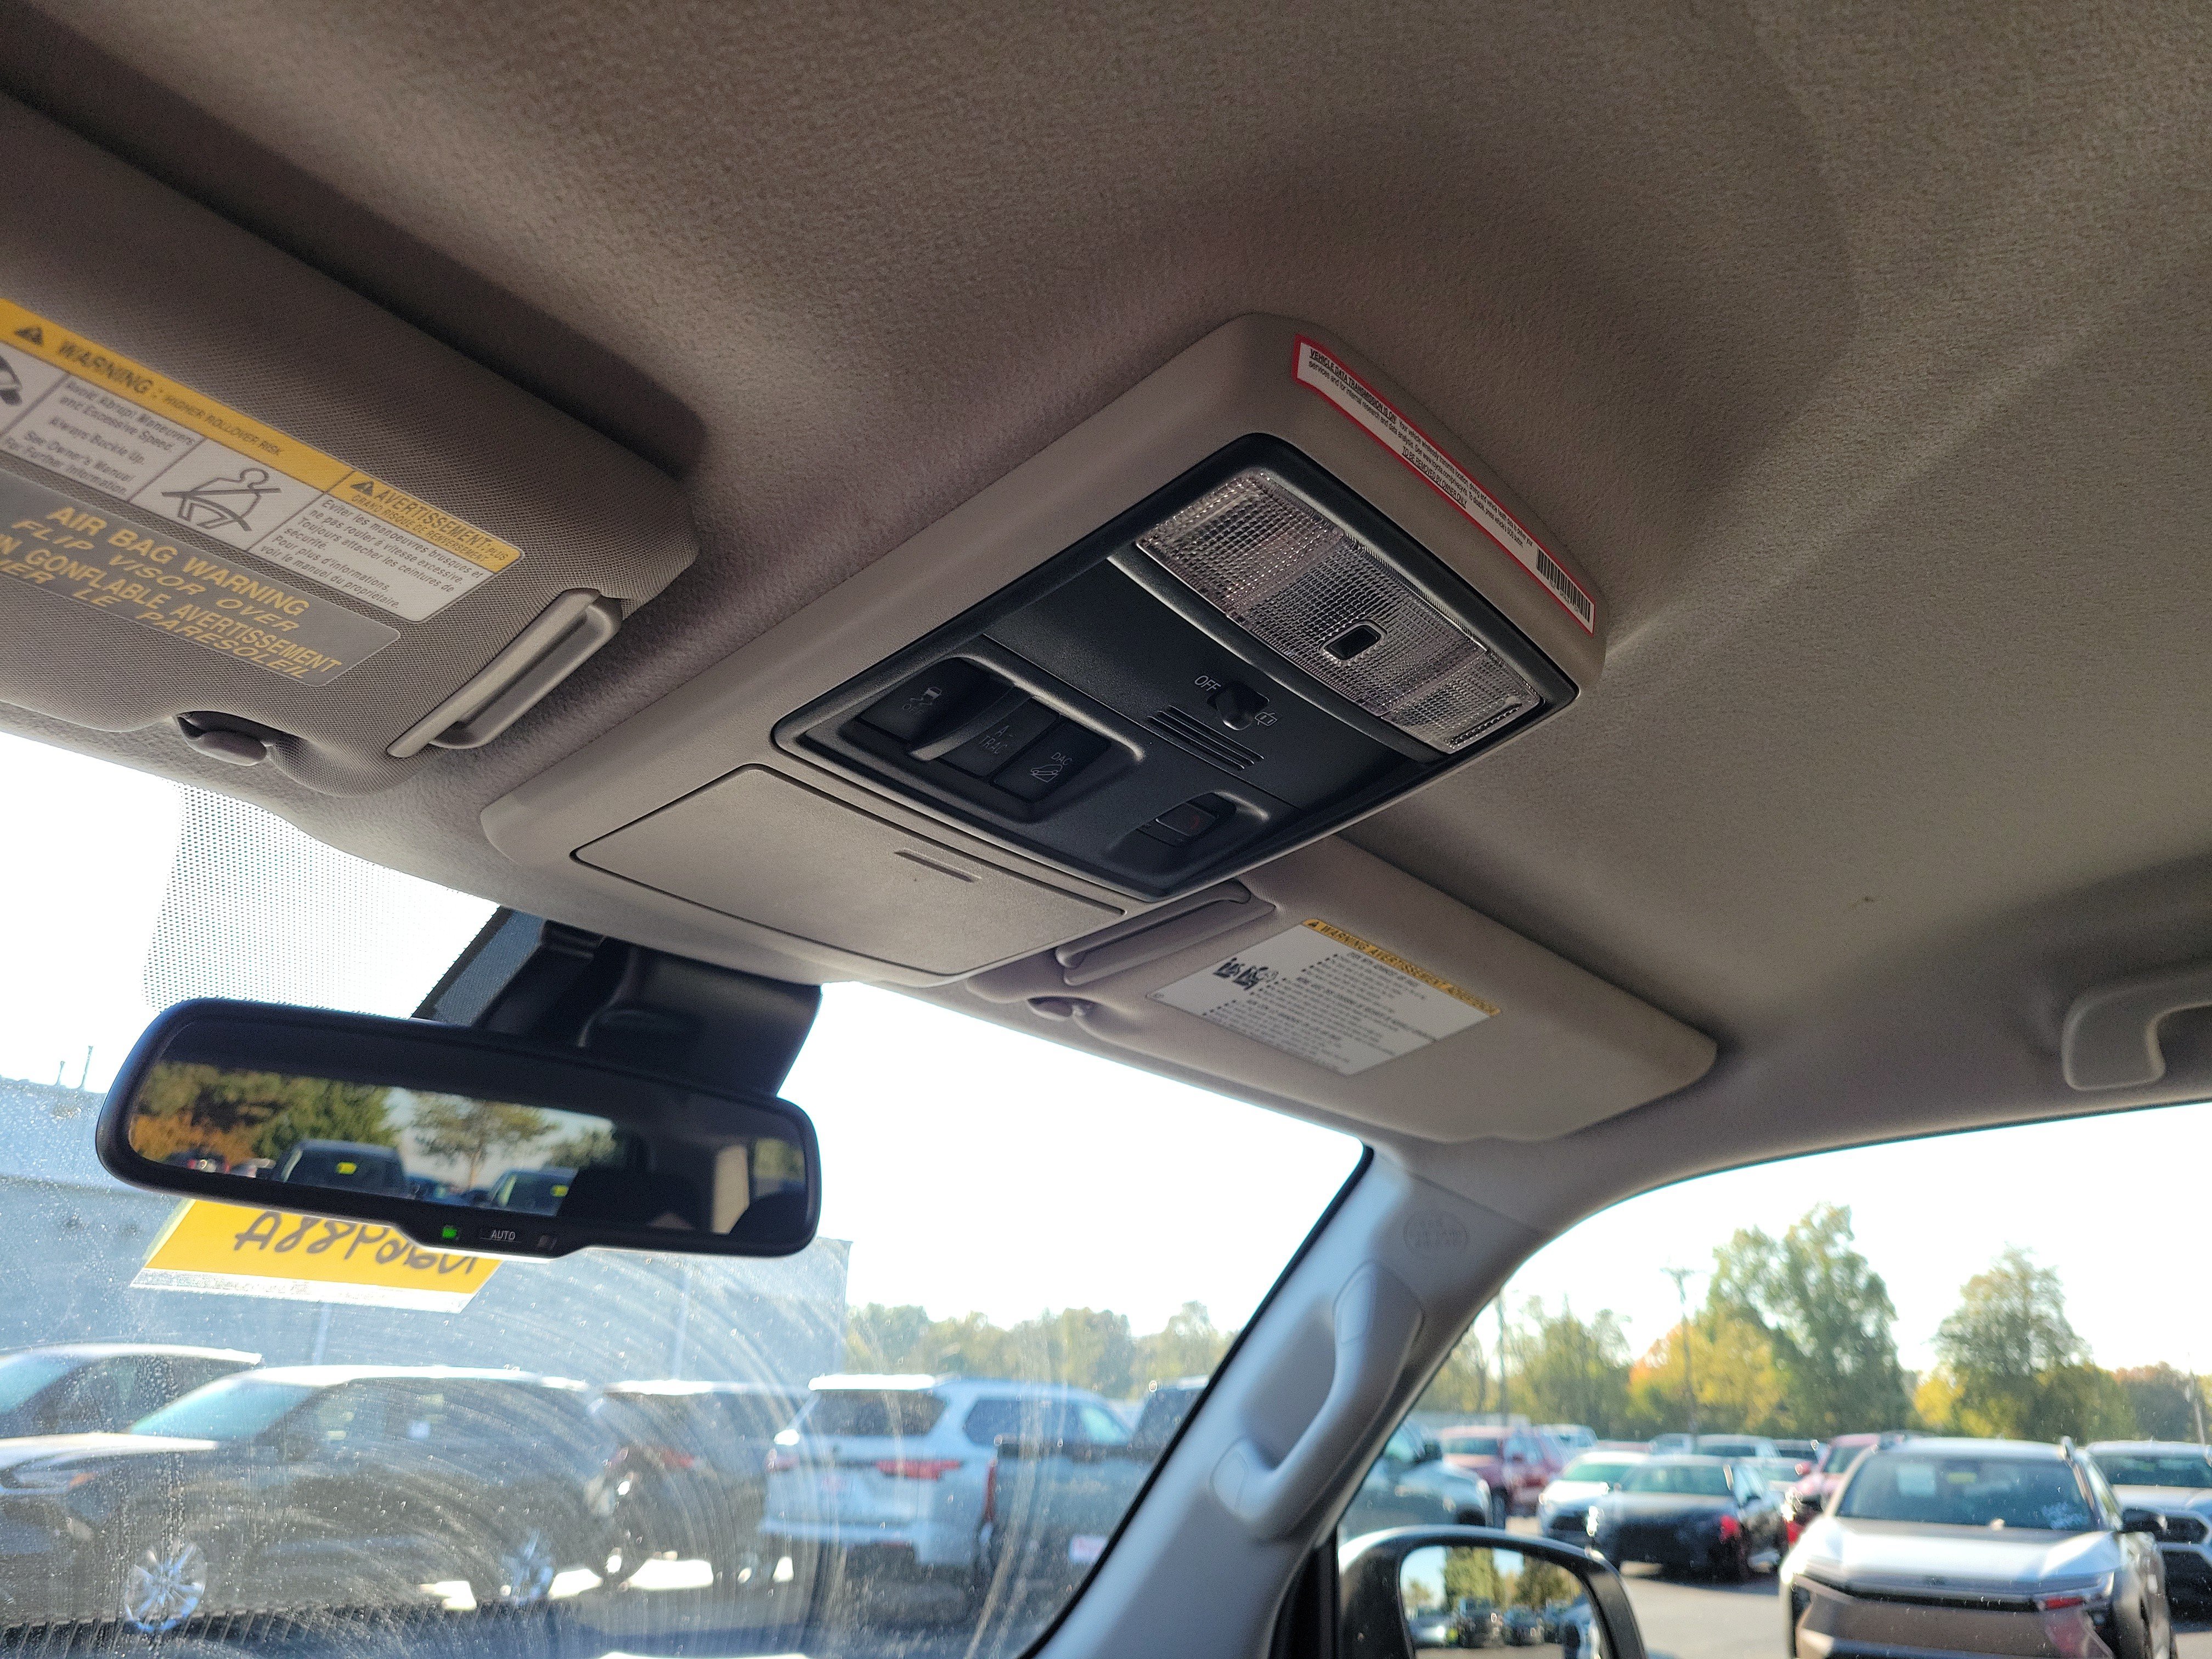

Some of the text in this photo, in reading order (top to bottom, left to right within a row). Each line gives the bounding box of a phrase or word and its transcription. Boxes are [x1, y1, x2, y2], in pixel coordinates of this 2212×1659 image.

[1308, 360, 1330, 379] services
[1330, 375, 1340, 387] and
[1362, 402, 1380, 420] research
[1310, 348, 1334, 372] VEHICLE
[1335, 366, 1348, 385] DATA
[1348, 377, 1383, 412] TRANSMISSION
[1402, 446, 1468, 507] TO BE REMOVED BY OWNER ONLY
[48, 507, 309, 615] AIR BAG WARNING
[261, 545, 283, 557] voir
[292, 558, 332, 578] manuel
[272, 535, 298, 550] Pour
[295, 548, 321, 562] plus
[296, 517, 343, 542] Toujours
[341, 538, 384, 560] attacher
[398, 564, 442, 586] ceintures
[322, 517, 344, 529] pas
[343, 526, 376, 542] rouler
[383, 543, 419, 562] vitesse
[369, 523, 429, 553] manoeuvres
[427, 550, 473, 574] brusques
[13, 520, 298, 631] FLIP VISOR OVER
[25, 549, 170, 609] GONFLABLE
[173, 603, 341, 672] AVERTISSEMENT
[74, 589, 122, 607] LE
[137, 610, 308, 678] PARESOLEIL
[1194, 675, 1221, 691] OFF
[979, 735, 1008, 754] TRAC
[1051, 752, 1072, 765] DAC
[491, 1229, 516, 1241] AUTO
